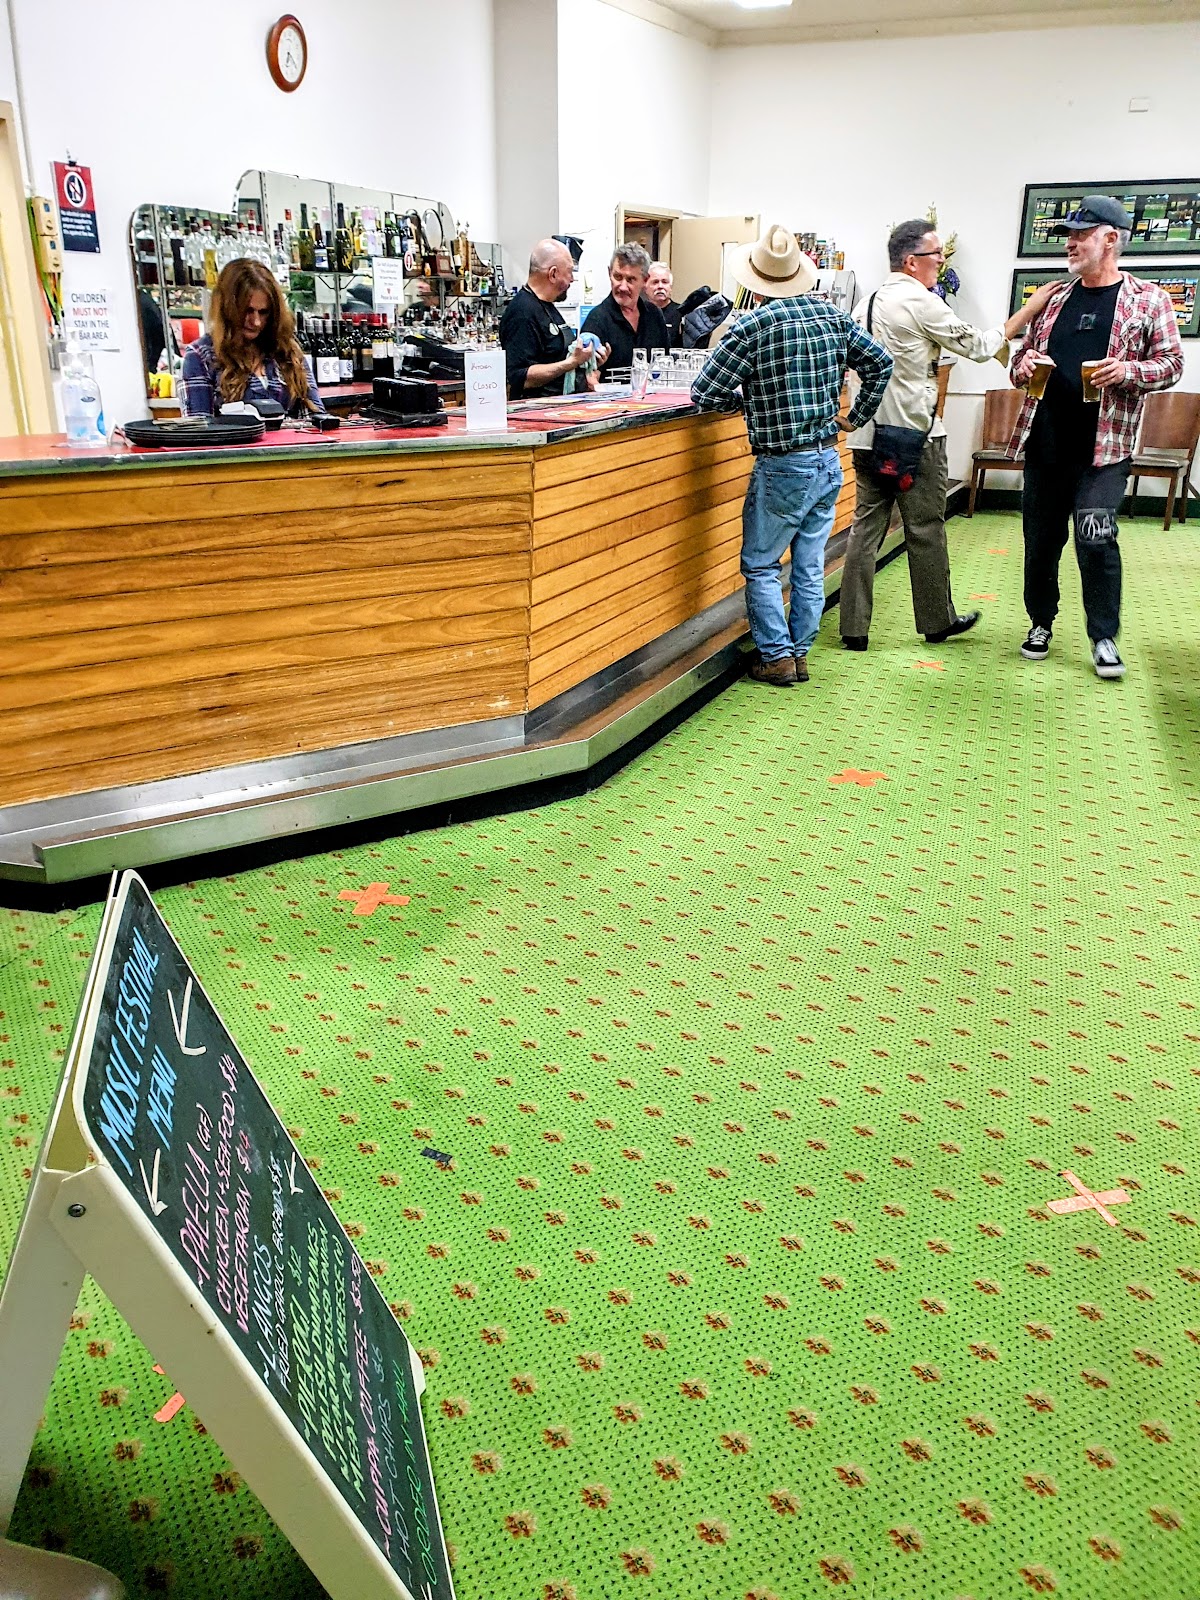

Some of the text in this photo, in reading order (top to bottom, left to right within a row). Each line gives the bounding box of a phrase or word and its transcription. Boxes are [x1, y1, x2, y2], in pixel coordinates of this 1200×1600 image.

[71, 293, 106, 303] CHILDREN
[73, 307, 107, 316] MUST NOT
[74, 320, 109, 328] STAY IN THE
[79, 331, 109, 340] BAR AREA
[100, 927, 159, 1177] MUSIC FESTIVAL
[147, 1045, 177, 1150] MENU
[180, 1102, 213, 1280] PAELLA (GF)
[215, 1190, 231, 1314] CHICKEN
[234, 1173, 252, 1334] VEGETARIAN
[252, 1234, 278, 1371] LANGOS
[273, 1255, 287, 1324] GARLIC
[275, 1323, 292, 1397] FRIED
[308, 1222, 336, 1461] POLISH DUMPLINGS
[335, 1264, 348, 1357] CHEESE
[290, 1294, 319, 1435] PIEROGI
[354, 1320, 376, 1434] COFFEE
[343, 1400, 366, 1502] MEAT
[366, 1436, 391, 1536] CUPPA
[378, 1394, 397, 1479] CHIPS
[401, 1424, 416, 1463] IN
[389, 1479, 412, 1564] HOT
[407, 1465, 437, 1585] ORDER
